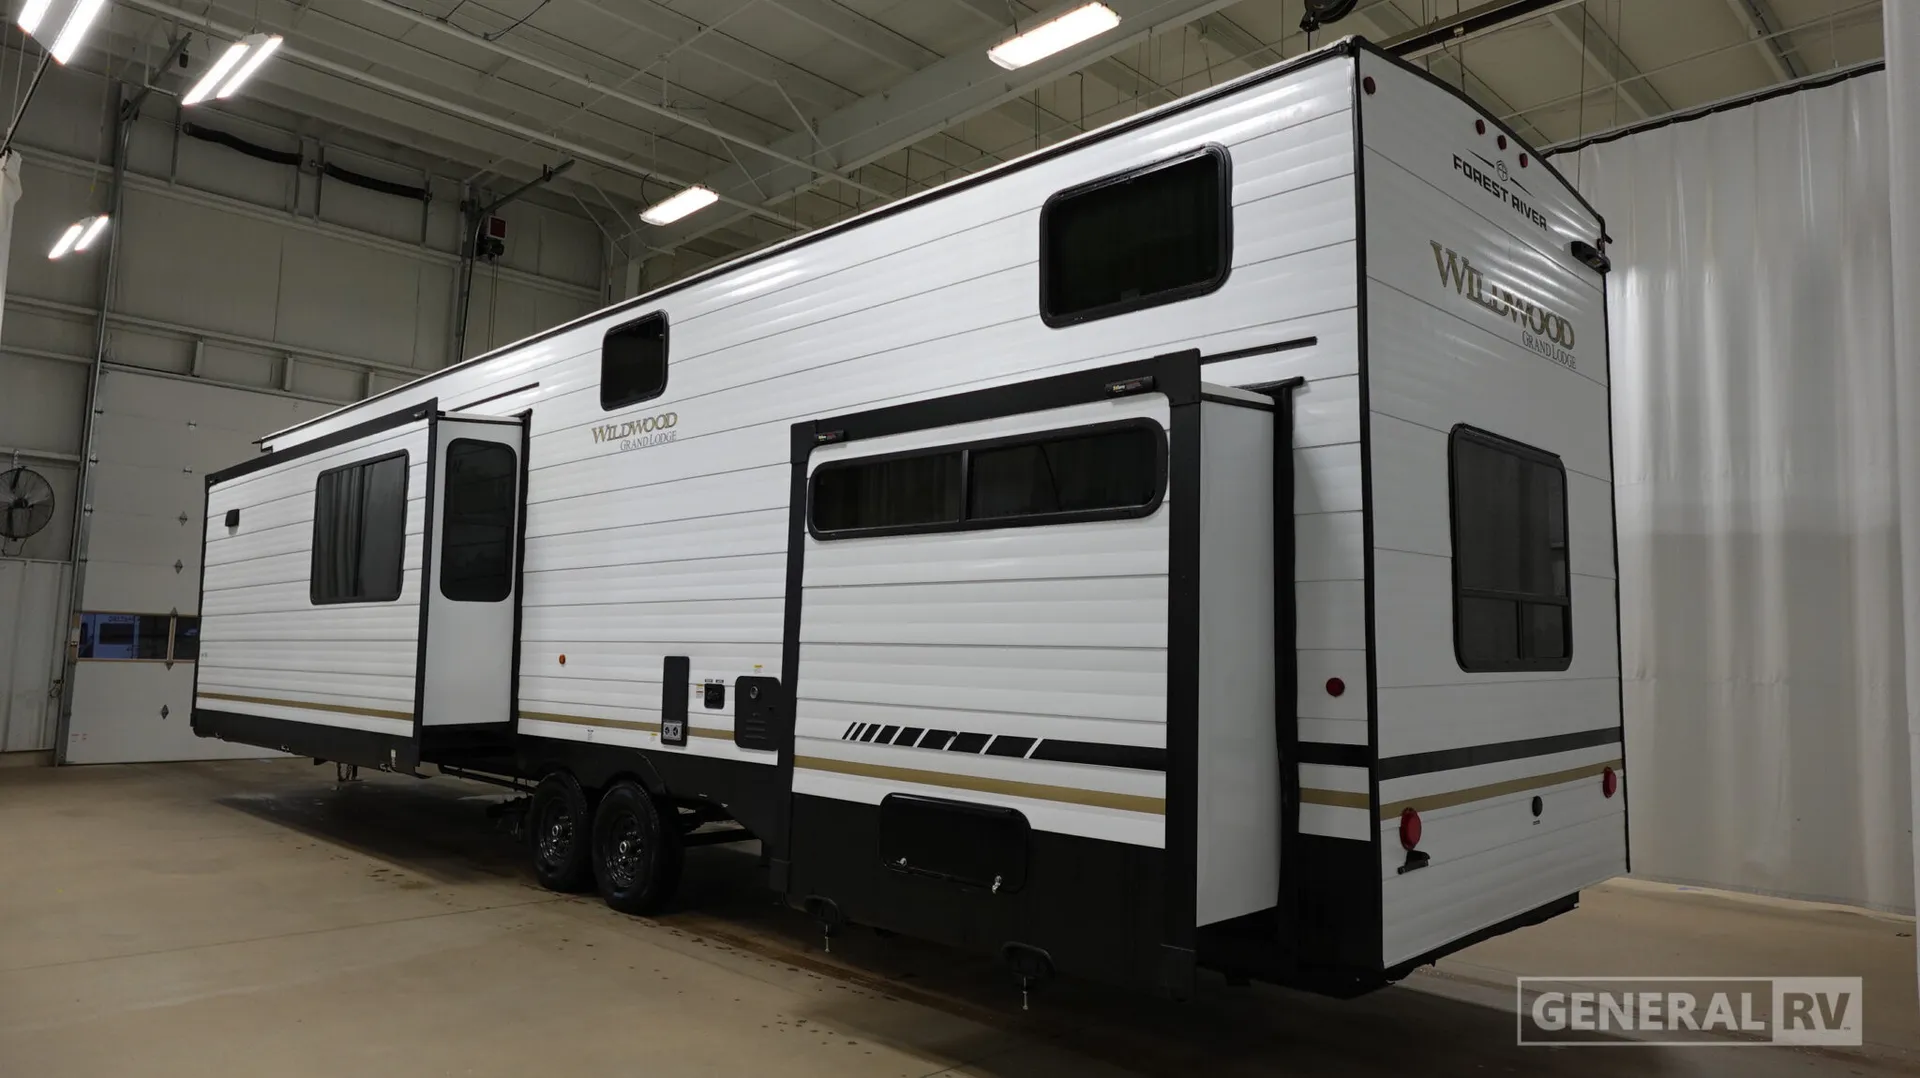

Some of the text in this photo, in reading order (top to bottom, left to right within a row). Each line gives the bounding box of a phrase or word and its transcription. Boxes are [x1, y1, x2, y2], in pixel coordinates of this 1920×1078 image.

[1452, 153, 1548, 231] FOREST RIVER
[1429, 239, 1575, 350] WILDWOOD
[1522, 330, 1577, 370] GRAND LODGE
[591, 412, 678, 444] WILDWOOD
[620, 430, 677, 451] GRAND LODGE
